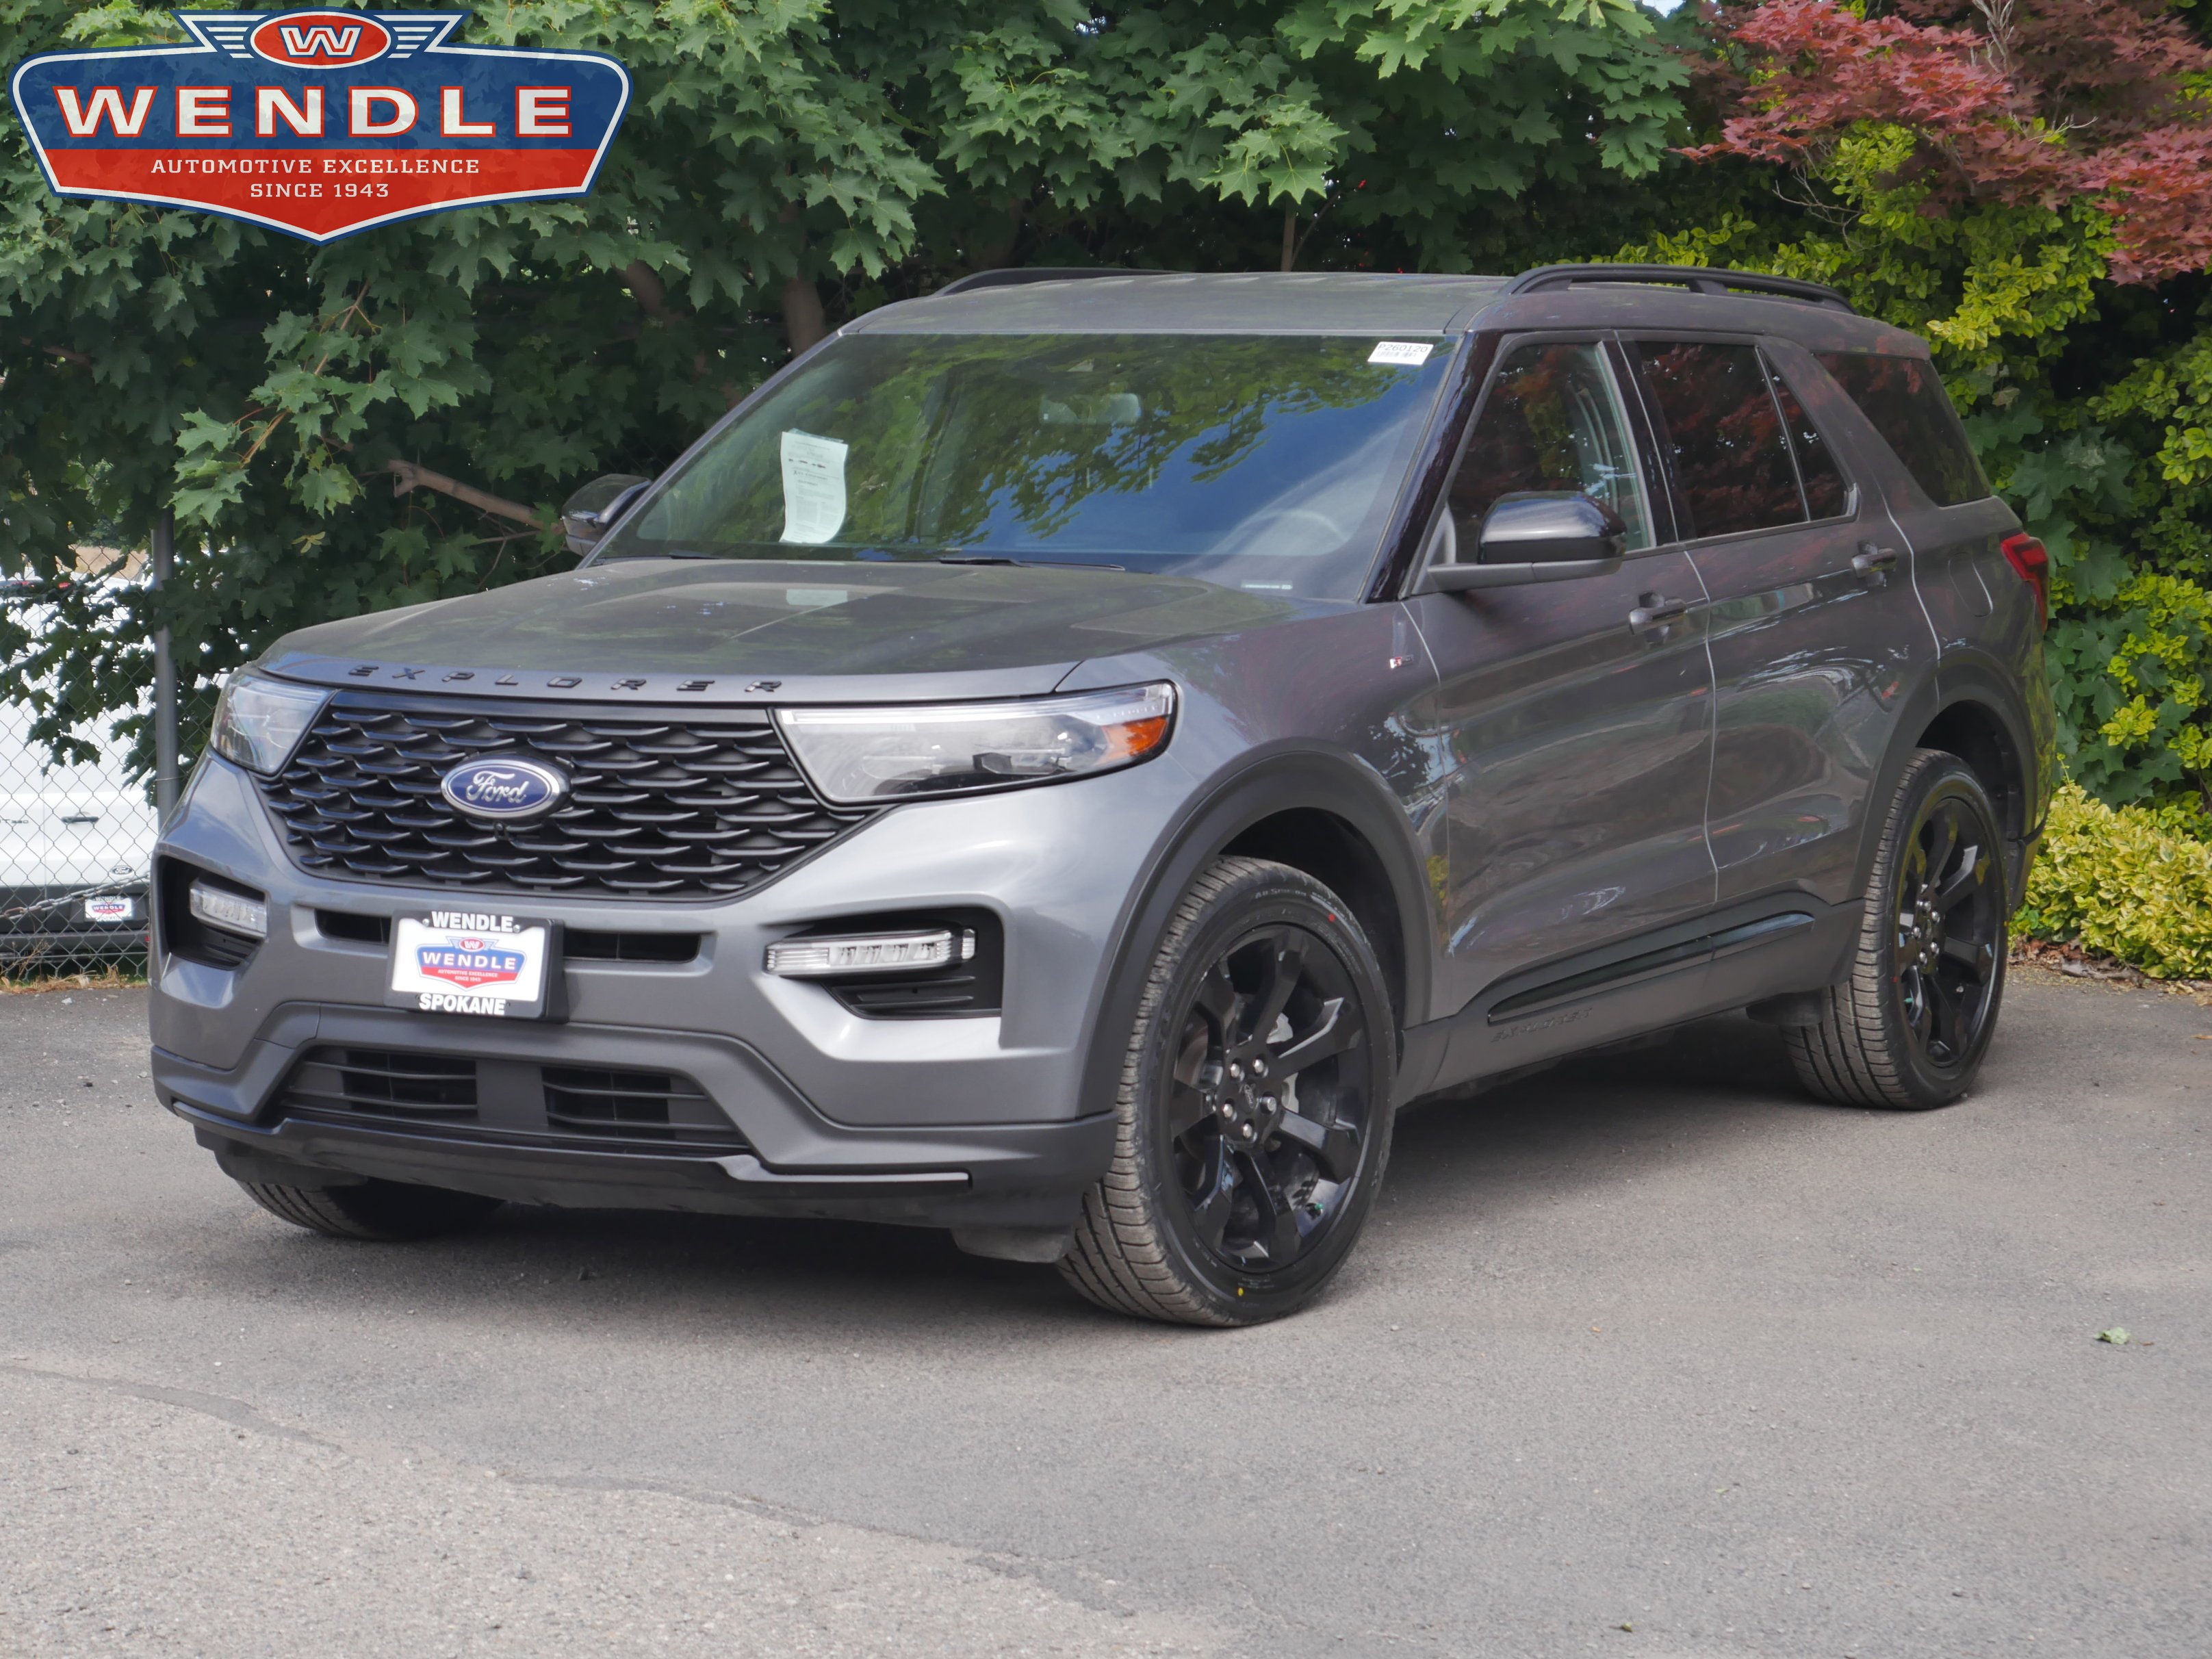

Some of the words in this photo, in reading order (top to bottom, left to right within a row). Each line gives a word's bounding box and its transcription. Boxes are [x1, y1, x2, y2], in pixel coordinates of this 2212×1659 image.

[1378, 344, 1428, 352] P260120
[348, 665, 782, 693] EXPLORER
[467, 771, 529, 803] Ford
[431, 911, 514, 933] WENDLE
[422, 951, 516, 970] WENDLE
[419, 992, 506, 1016] SPOKANE
